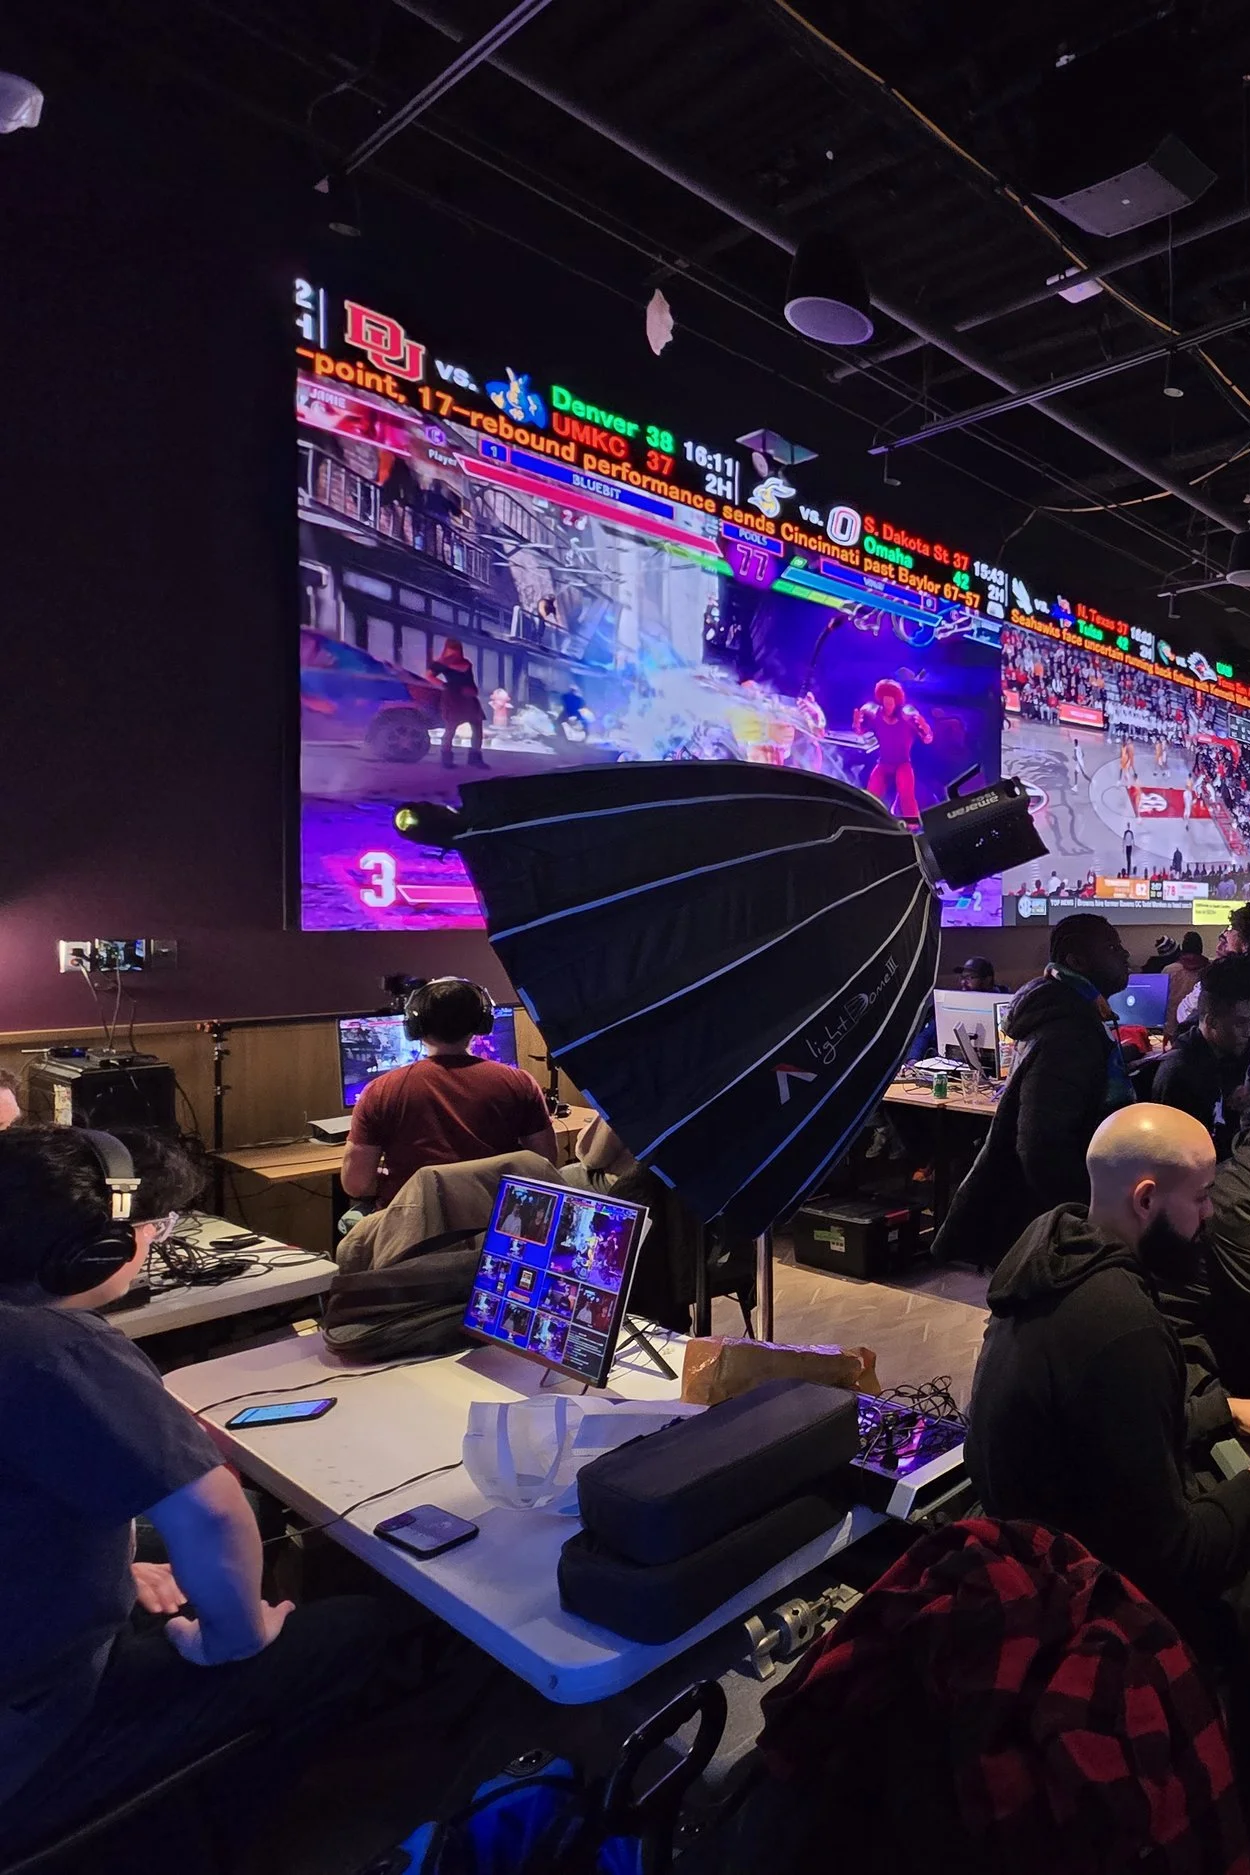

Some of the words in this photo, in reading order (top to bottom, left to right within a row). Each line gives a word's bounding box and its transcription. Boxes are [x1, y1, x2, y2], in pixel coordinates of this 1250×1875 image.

[344, 300, 426, 382] DU
[435, 359, 479, 393] vs.
[551, 385, 639, 438] Denver
[645, 425, 674, 453] 38
[552, 412, 628, 458] UMKC
[646, 450, 674, 476] 37
[704, 473, 735, 500] 2H
[417, 385, 576, 463] 17-rebound
[583, 451, 717, 514] performance
[722, 503, 776, 536] sends
[780, 522, 861, 566] Cincinnati
[863, 557, 896, 583] past
[898, 569, 942, 600] Baylor
[943, 584, 981, 609] 67-57
[572, 473, 622, 501] BLUEBIT
[799, 504, 824, 528] vs.
[736, 544, 770, 582] 77
[864, 516, 879, 538] S.
[882, 524, 931, 559] Dakota
[952, 551, 970, 572] 37
[973, 560, 1005, 587] 15:43
[864, 535, 914, 570] Omaha
[952, 570, 970, 591] 42
[987, 583, 1005, 602] 2H
[1011, 608, 1060, 639] Seahawks
[1062, 628, 1083, 646] face
[1084, 639, 1124, 661] uncertain
[1077, 619, 1104, 641] Tulsa
[1088, 608, 1115, 631] Texas
[946, 795, 999, 819] amaran
[358, 850, 398, 909] 3
